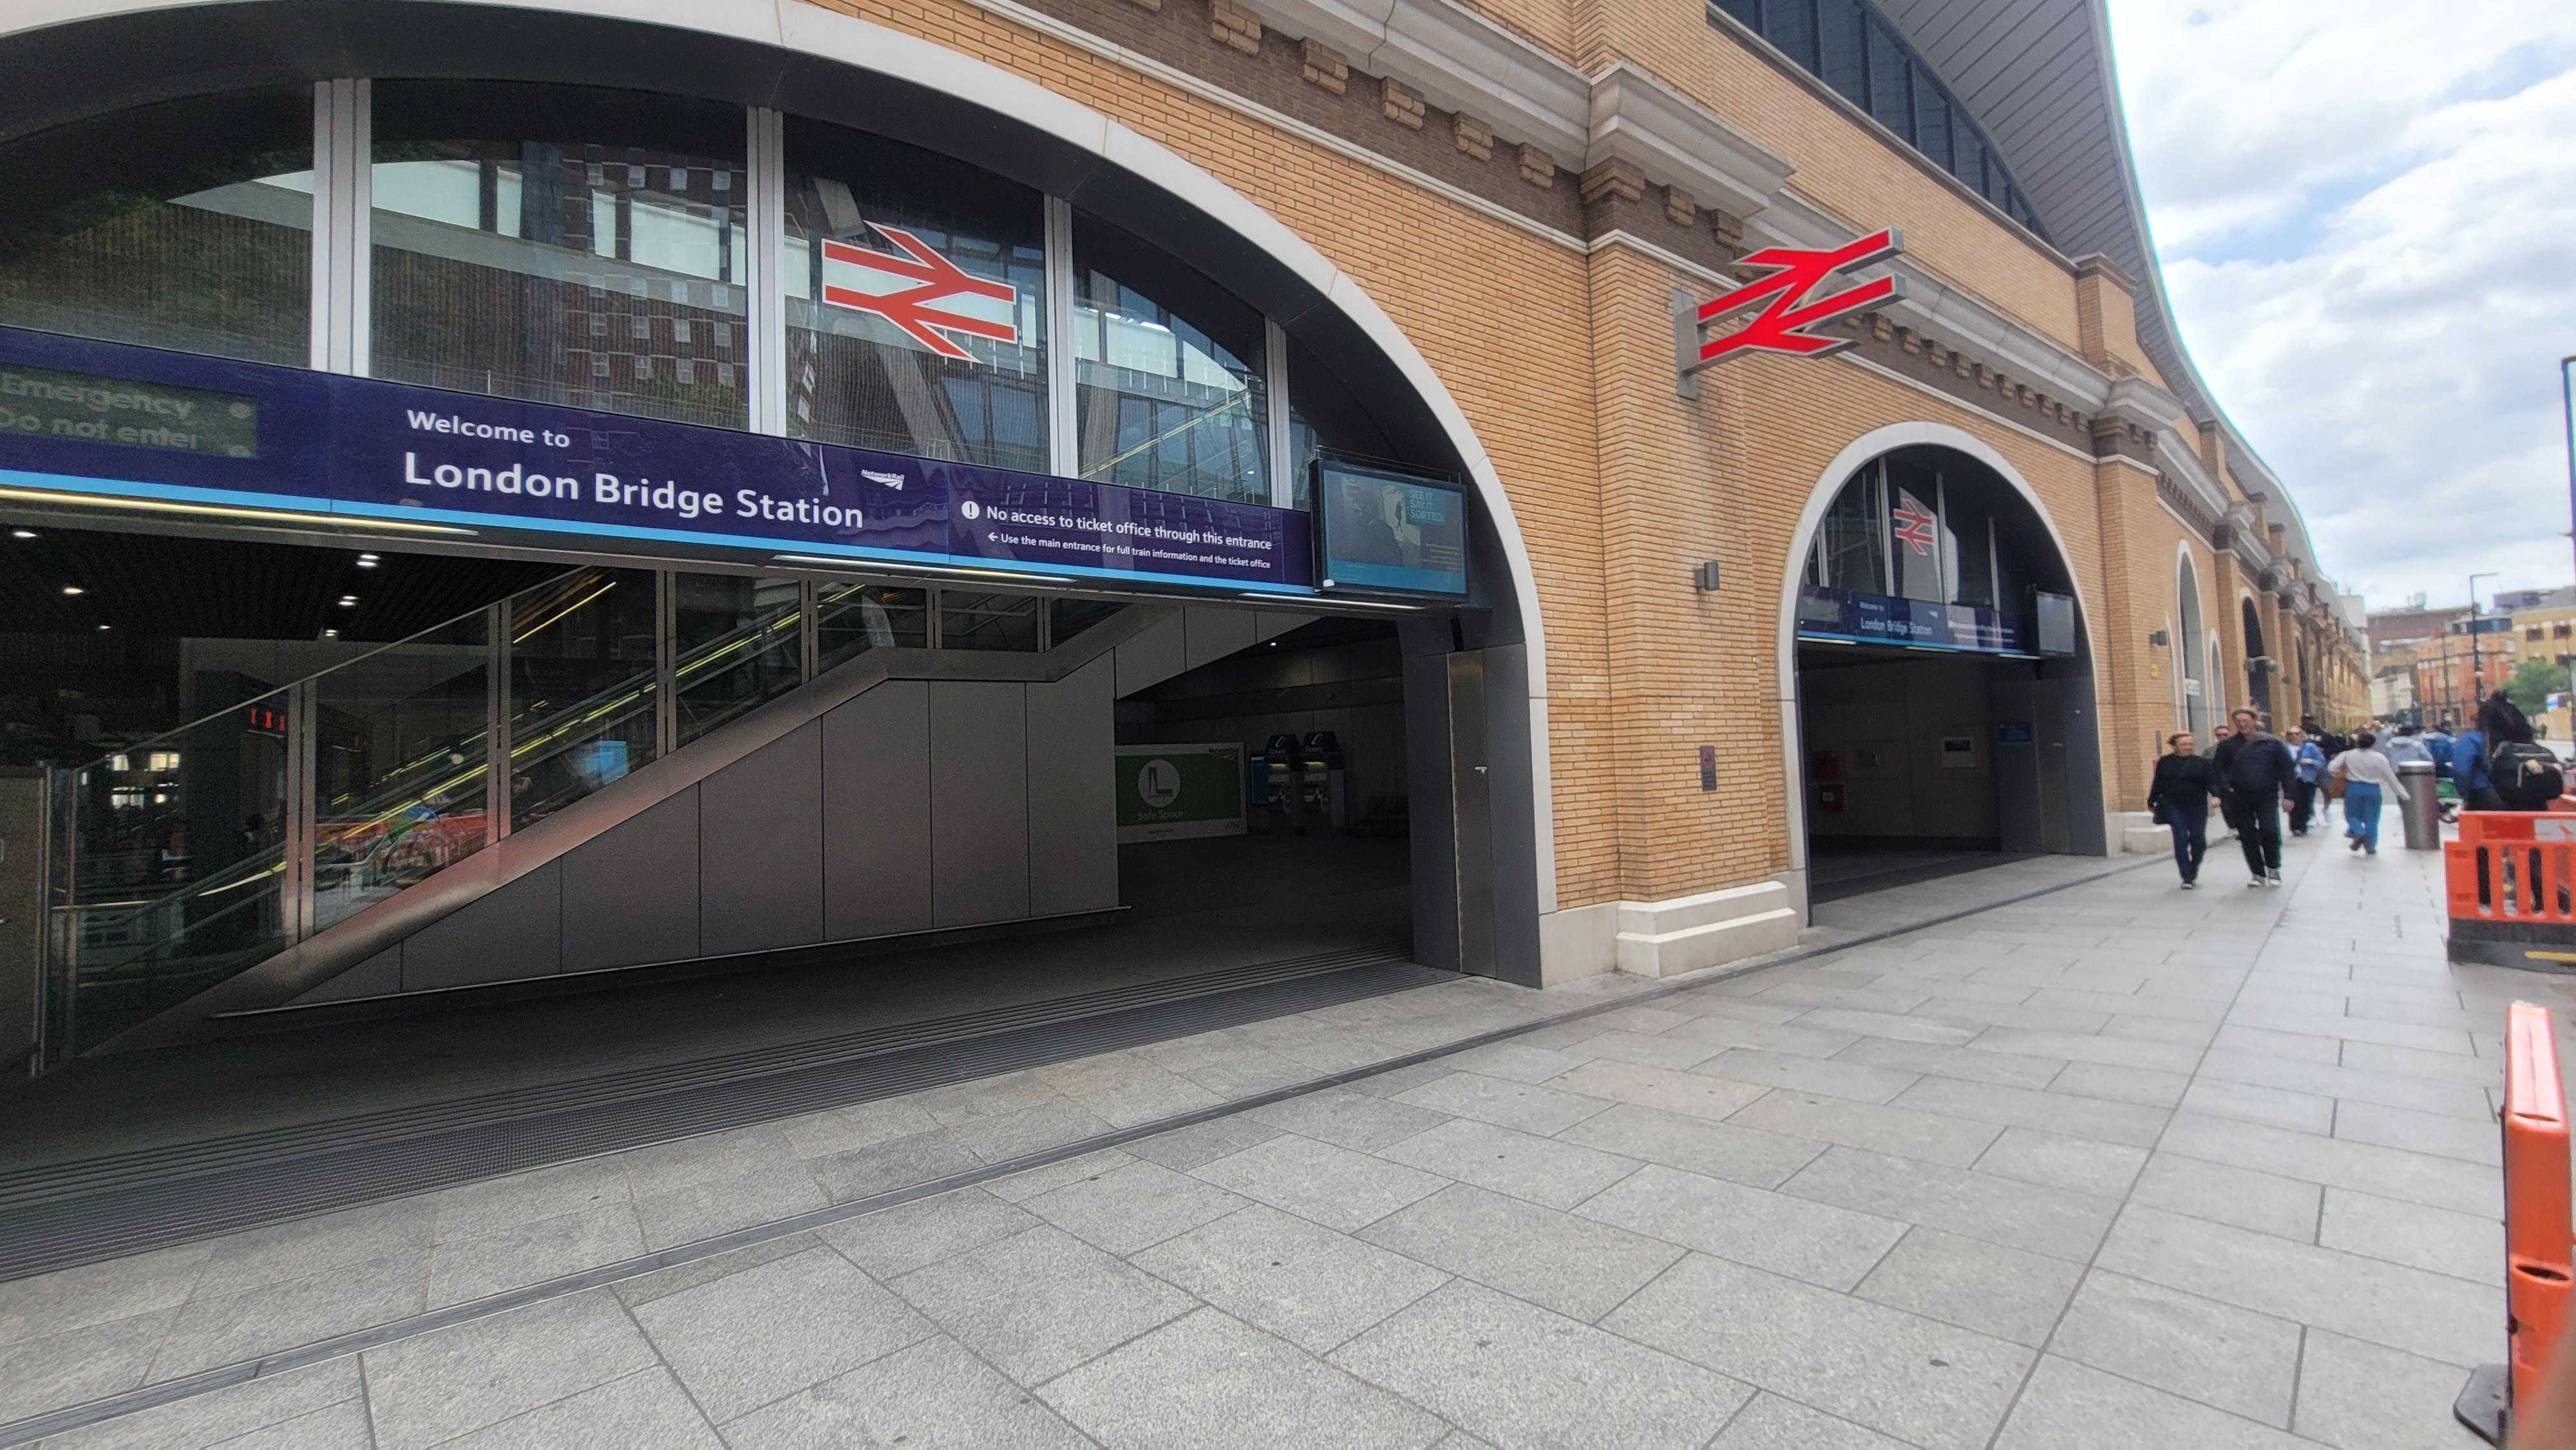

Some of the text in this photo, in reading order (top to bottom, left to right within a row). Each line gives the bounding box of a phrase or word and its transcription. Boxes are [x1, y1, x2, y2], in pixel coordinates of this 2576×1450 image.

[2, 372, 192, 419] Emergency
[52, 419, 110, 440] not
[406, 410, 571, 447] Welcome to
[406, 451, 864, 529] London Bridge Station
[987, 505, 1272, 550] No access to ticket office through this entrance
[1001, 533, 1271, 569] Use the main entrance for full train information and the ticket office
[1861, 616, 1886, 631] London
[1887, 619, 1908, 636] Bridge
[1137, 809, 1185, 822] Safe Space
